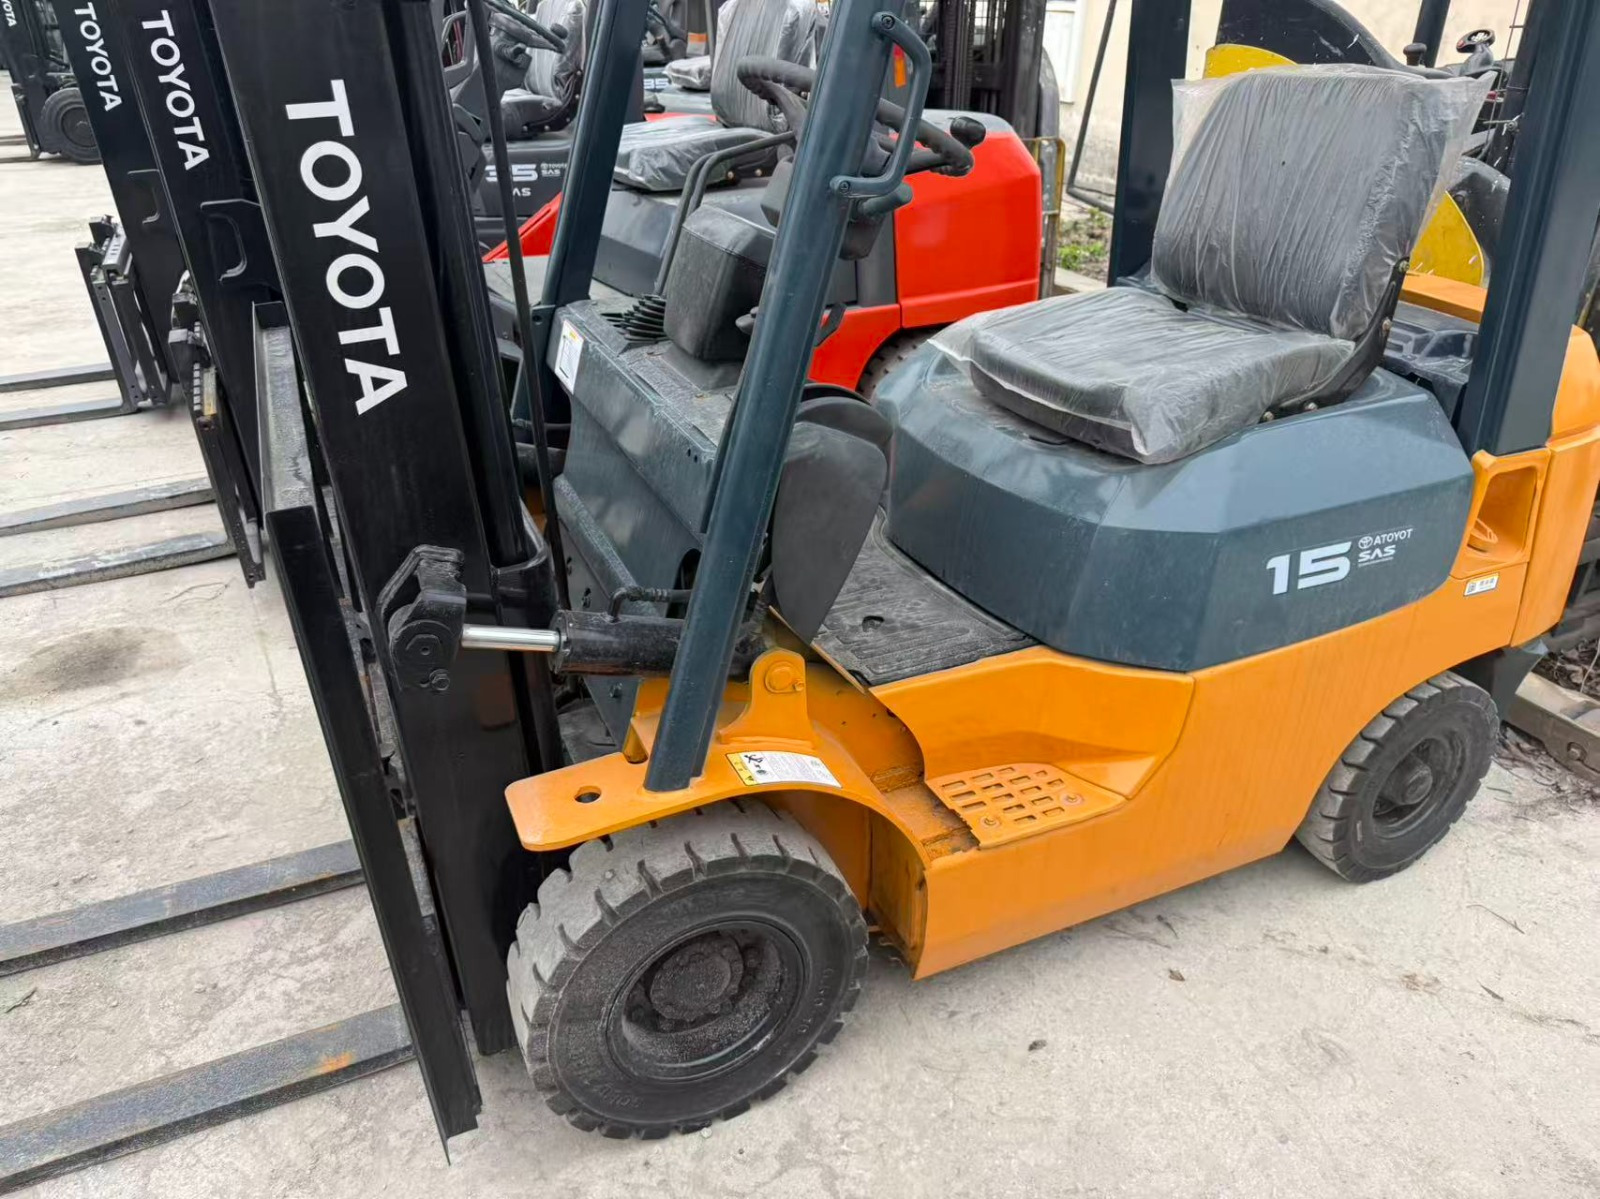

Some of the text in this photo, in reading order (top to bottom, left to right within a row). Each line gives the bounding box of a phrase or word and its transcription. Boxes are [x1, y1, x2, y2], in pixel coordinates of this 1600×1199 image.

[74, 1, 122, 112] TOYOTA
[141, 9, 210, 171] TOYOTA
[285, 79, 408, 416] TOYOTA
[1266, 541, 1352, 595] 15
[1358, 545, 1396, 563] SAS
[1373, 528, 1413, 545] ATOYOT
